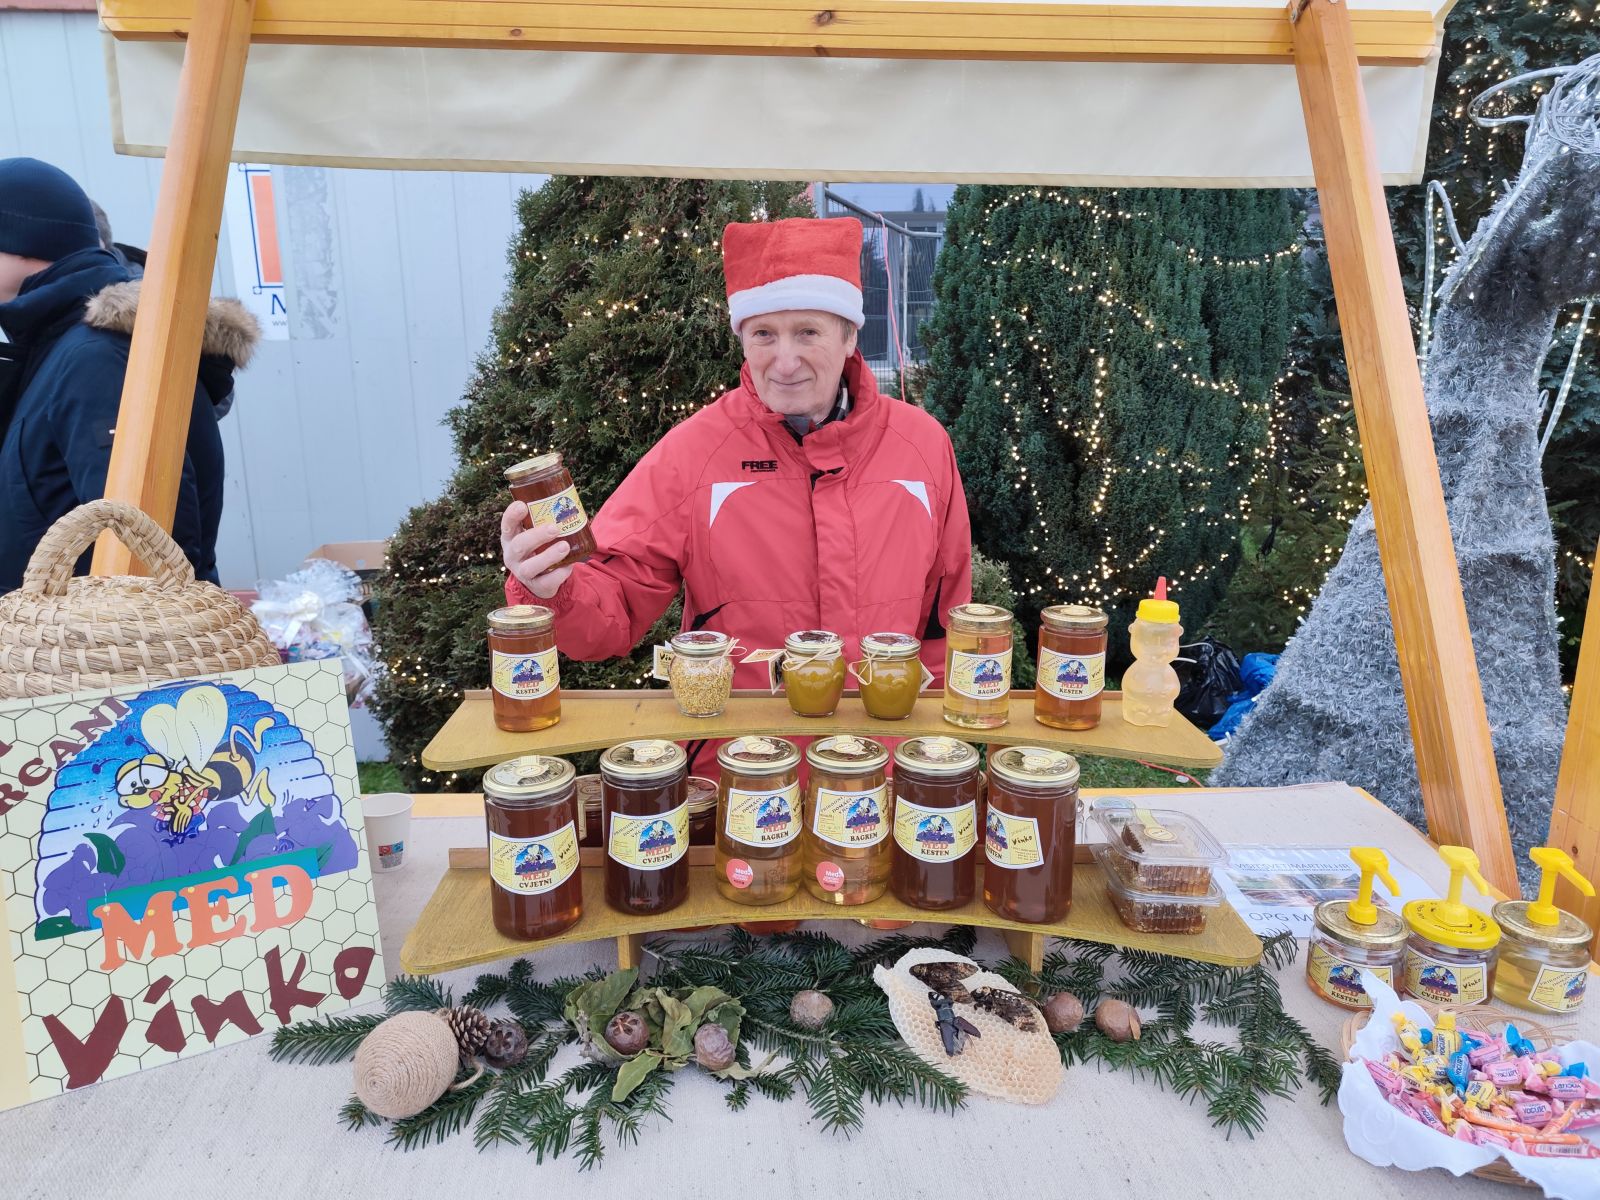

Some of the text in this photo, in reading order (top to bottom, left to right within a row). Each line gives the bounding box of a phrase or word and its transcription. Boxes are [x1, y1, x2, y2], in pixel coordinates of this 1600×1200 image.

[741, 460, 778, 470] FREE
[761, 831, 789, 842] BAGREM
[850, 832, 878, 842] BAGREM
[1011, 835, 1033, 845] Vinko
[645, 845, 672, 857] MED
[921, 848, 950, 856] KESTEN
[642, 853, 673, 865] CVJETNI
[519, 878, 553, 889] CVJETNI
[93, 864, 314, 970] MED
[1249, 912, 1290, 922] OPG
[1331, 990, 1359, 1003] KESTEN
[1421, 992, 1453, 1003] CVJETNI
[42, 945, 375, 1089] Vinko
[1523, 1105, 1547, 1114] YOGURT
